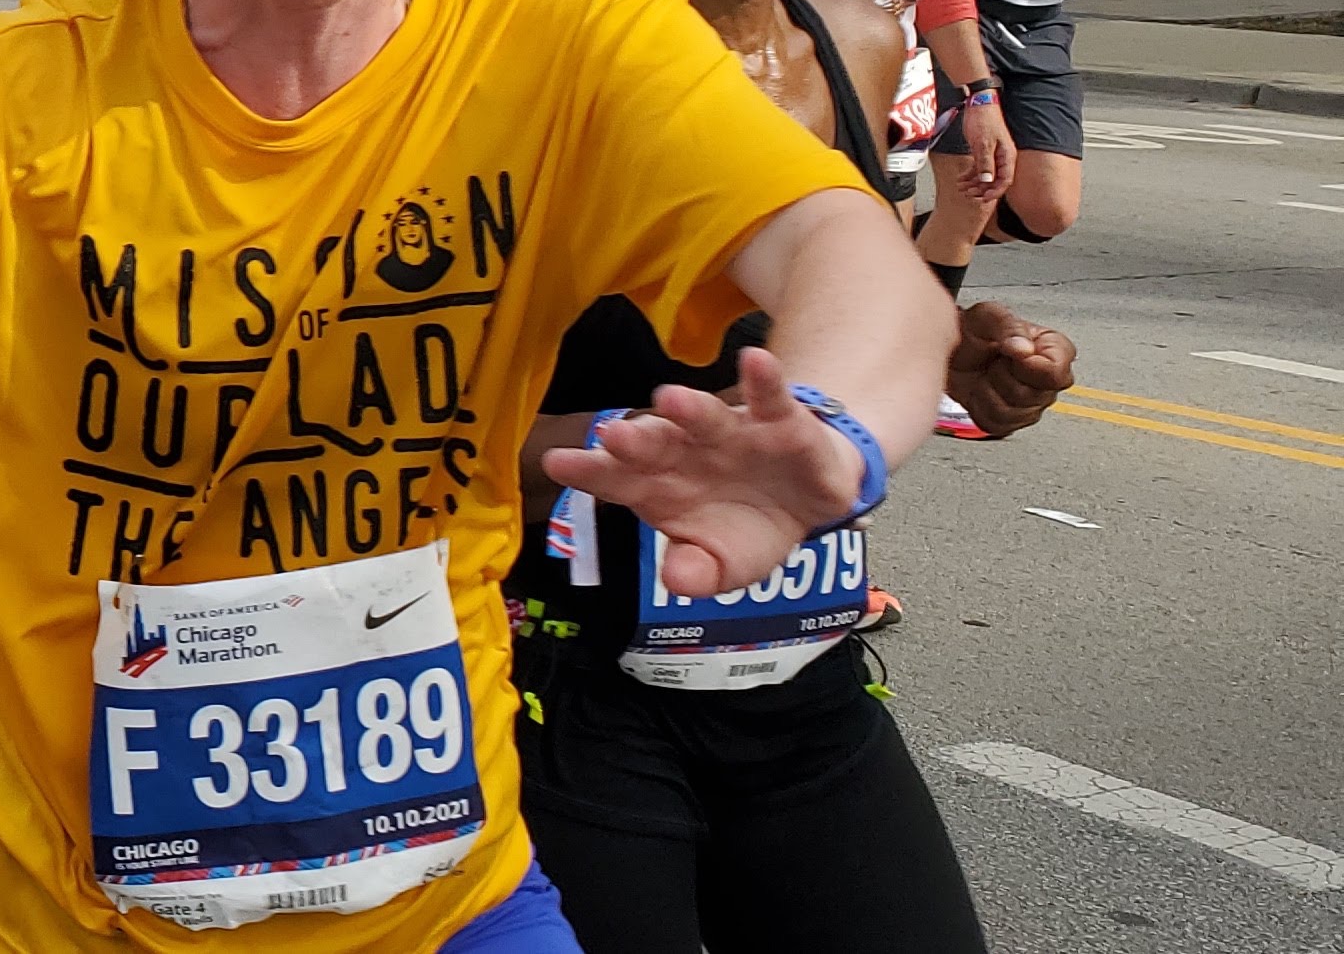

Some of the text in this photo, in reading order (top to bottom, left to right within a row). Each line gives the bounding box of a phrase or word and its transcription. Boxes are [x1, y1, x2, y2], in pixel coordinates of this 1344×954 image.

[297, 308, 331, 342] OF
[286, 323, 458, 456] LAD
[173, 602, 281, 621] BANK OF AMERICA
[175, 624, 257, 644] Chicago
[647, 626, 705, 640] CHICAGO
[105, 667, 464, 816] F 33189
[364, 798, 470, 836] 10.10.2021
[113, 838, 200, 861] CHICAGO
[152, 902, 192, 916] Gate
